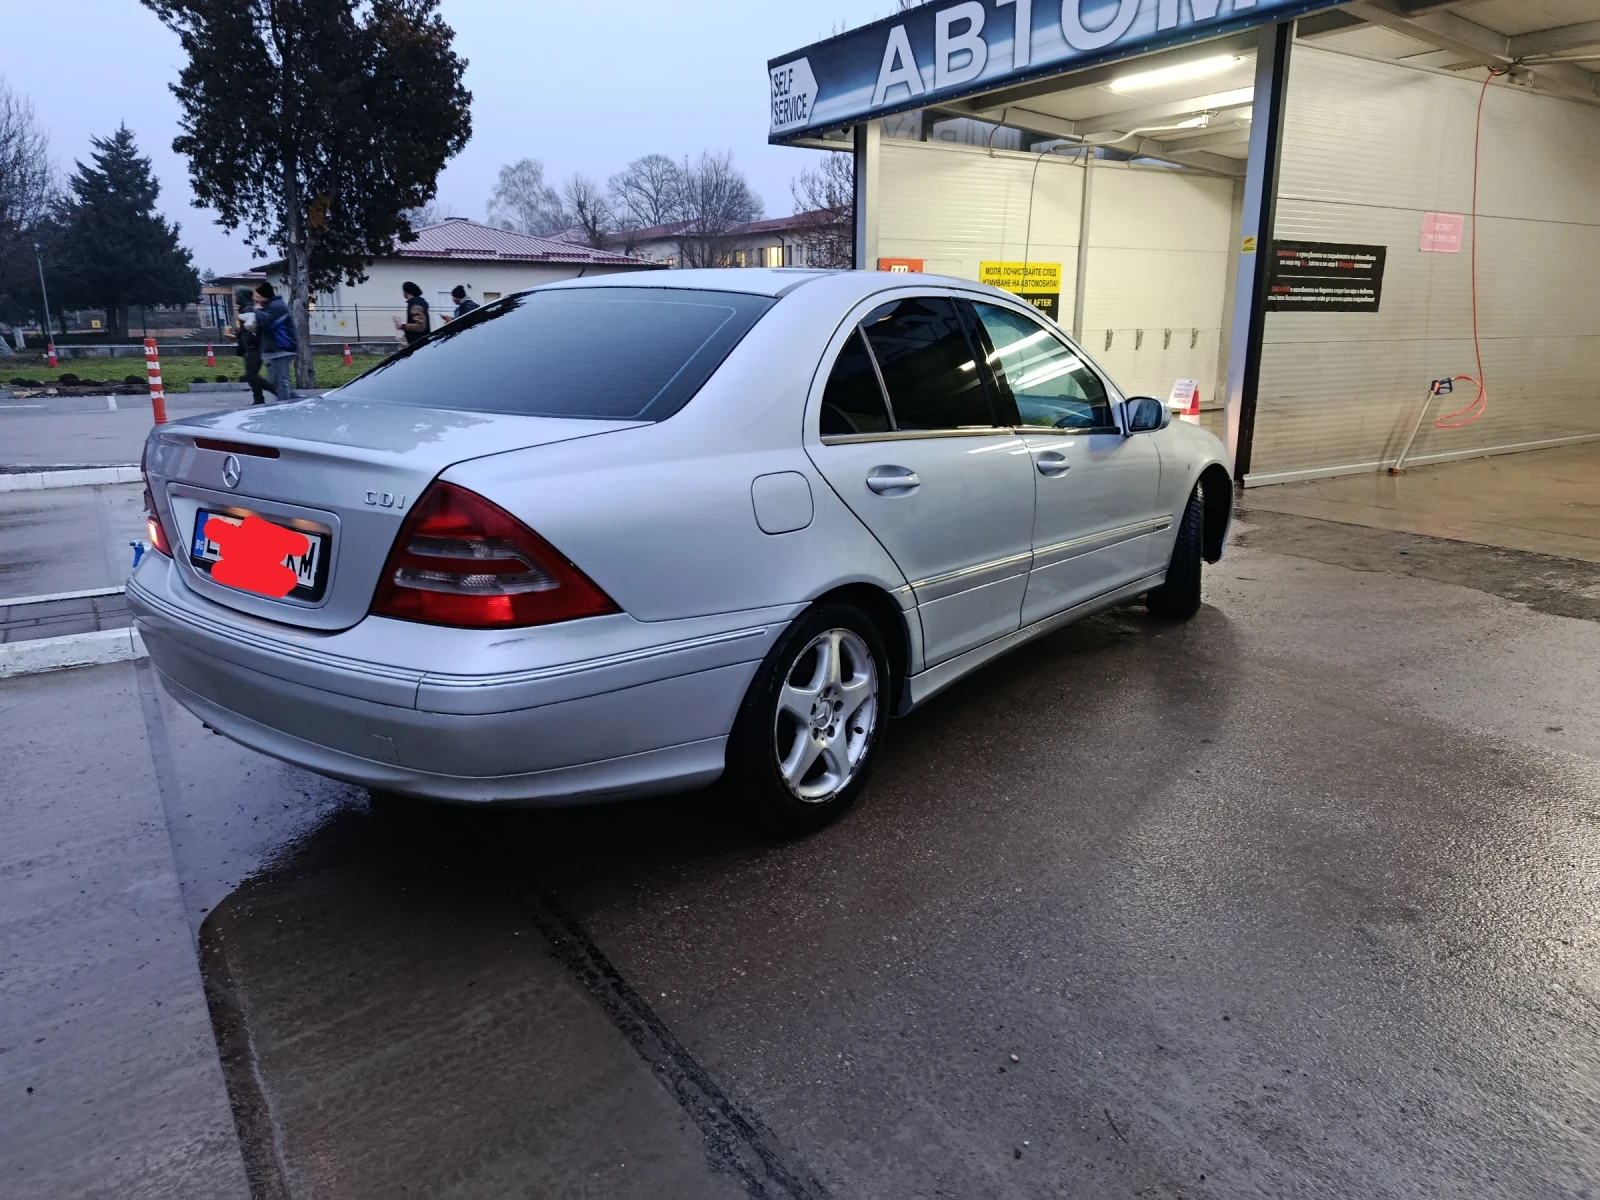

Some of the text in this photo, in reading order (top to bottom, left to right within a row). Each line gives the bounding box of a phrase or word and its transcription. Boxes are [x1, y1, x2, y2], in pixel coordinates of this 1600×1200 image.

[773, 68, 793, 98] SELF
[773, 93, 807, 126] SERVICE
[1012, 279, 1020, 287] НА
[1032, 298, 1052, 307] AFTER
[364, 490, 405, 509] CDI
[195, 539, 204, 550] BG
